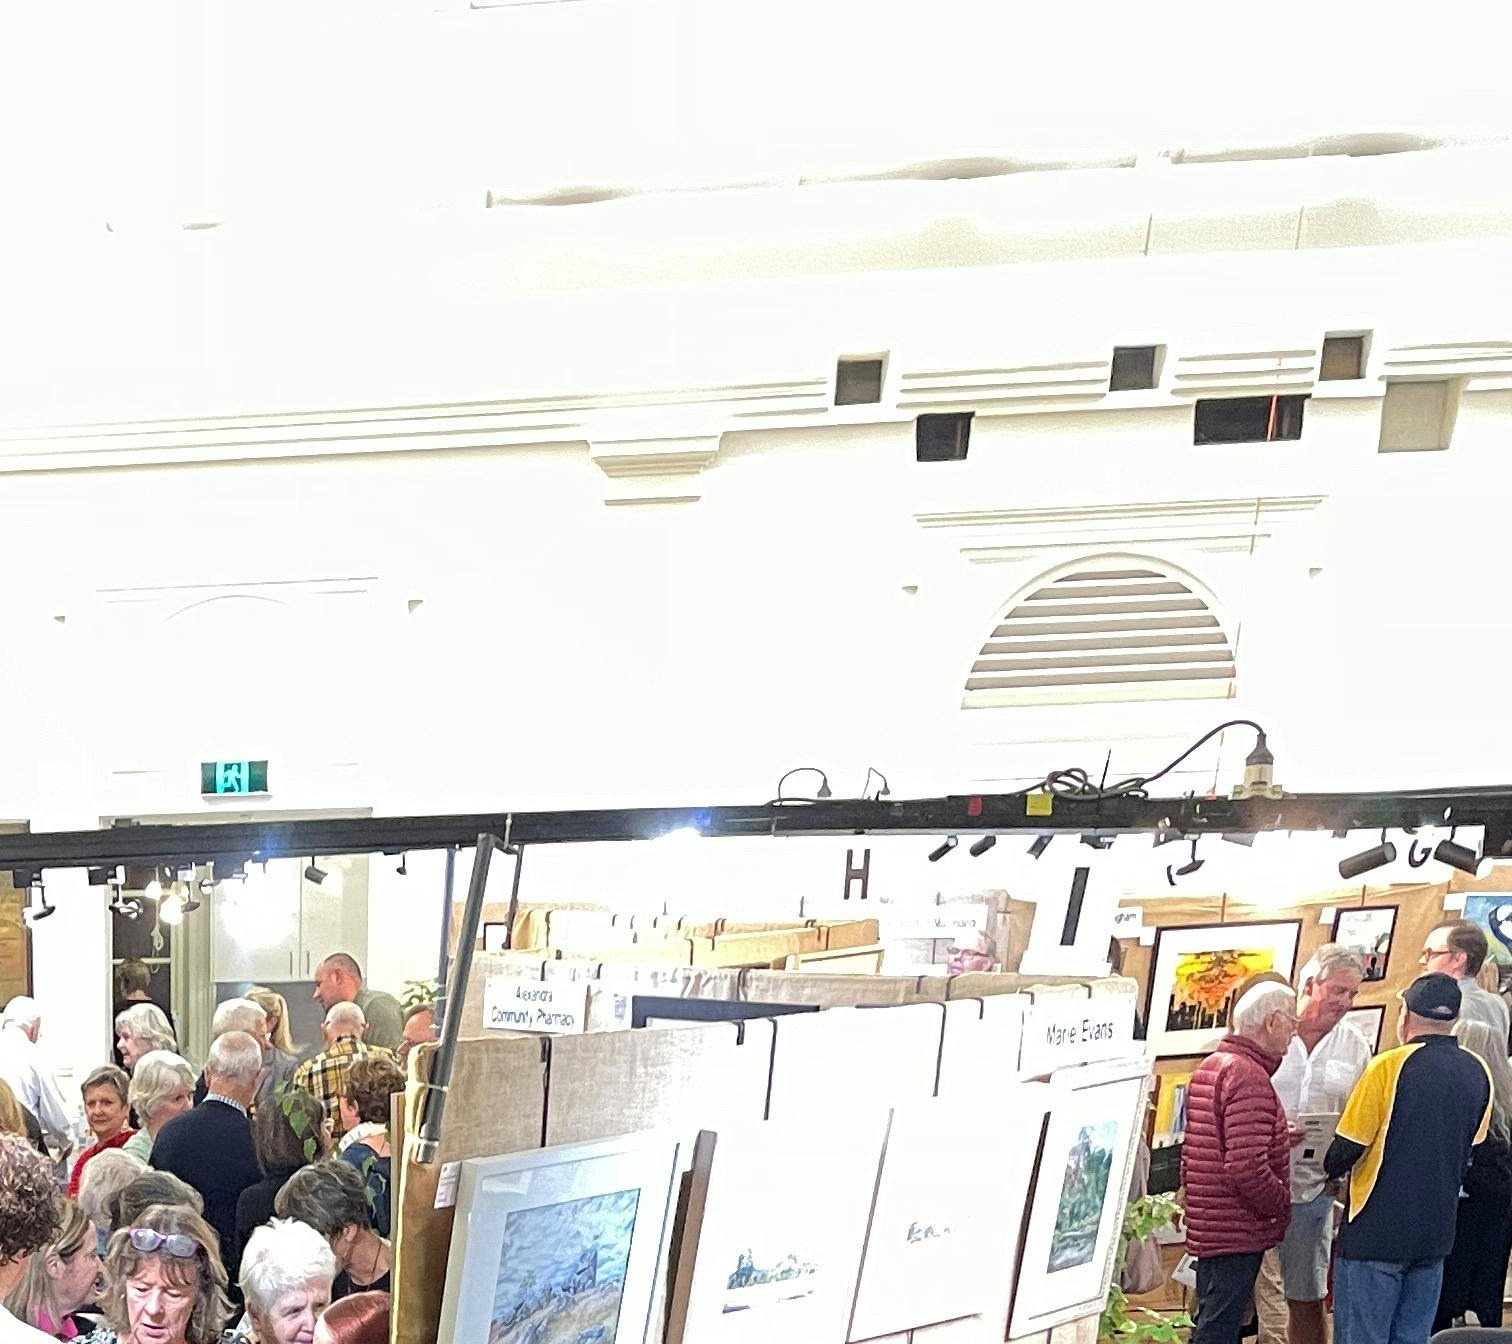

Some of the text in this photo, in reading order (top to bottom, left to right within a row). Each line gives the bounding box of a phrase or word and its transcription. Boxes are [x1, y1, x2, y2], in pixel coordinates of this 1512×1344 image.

[844, 848, 870, 900] H
[1046, 1018, 1114, 1046] Marie Evans
